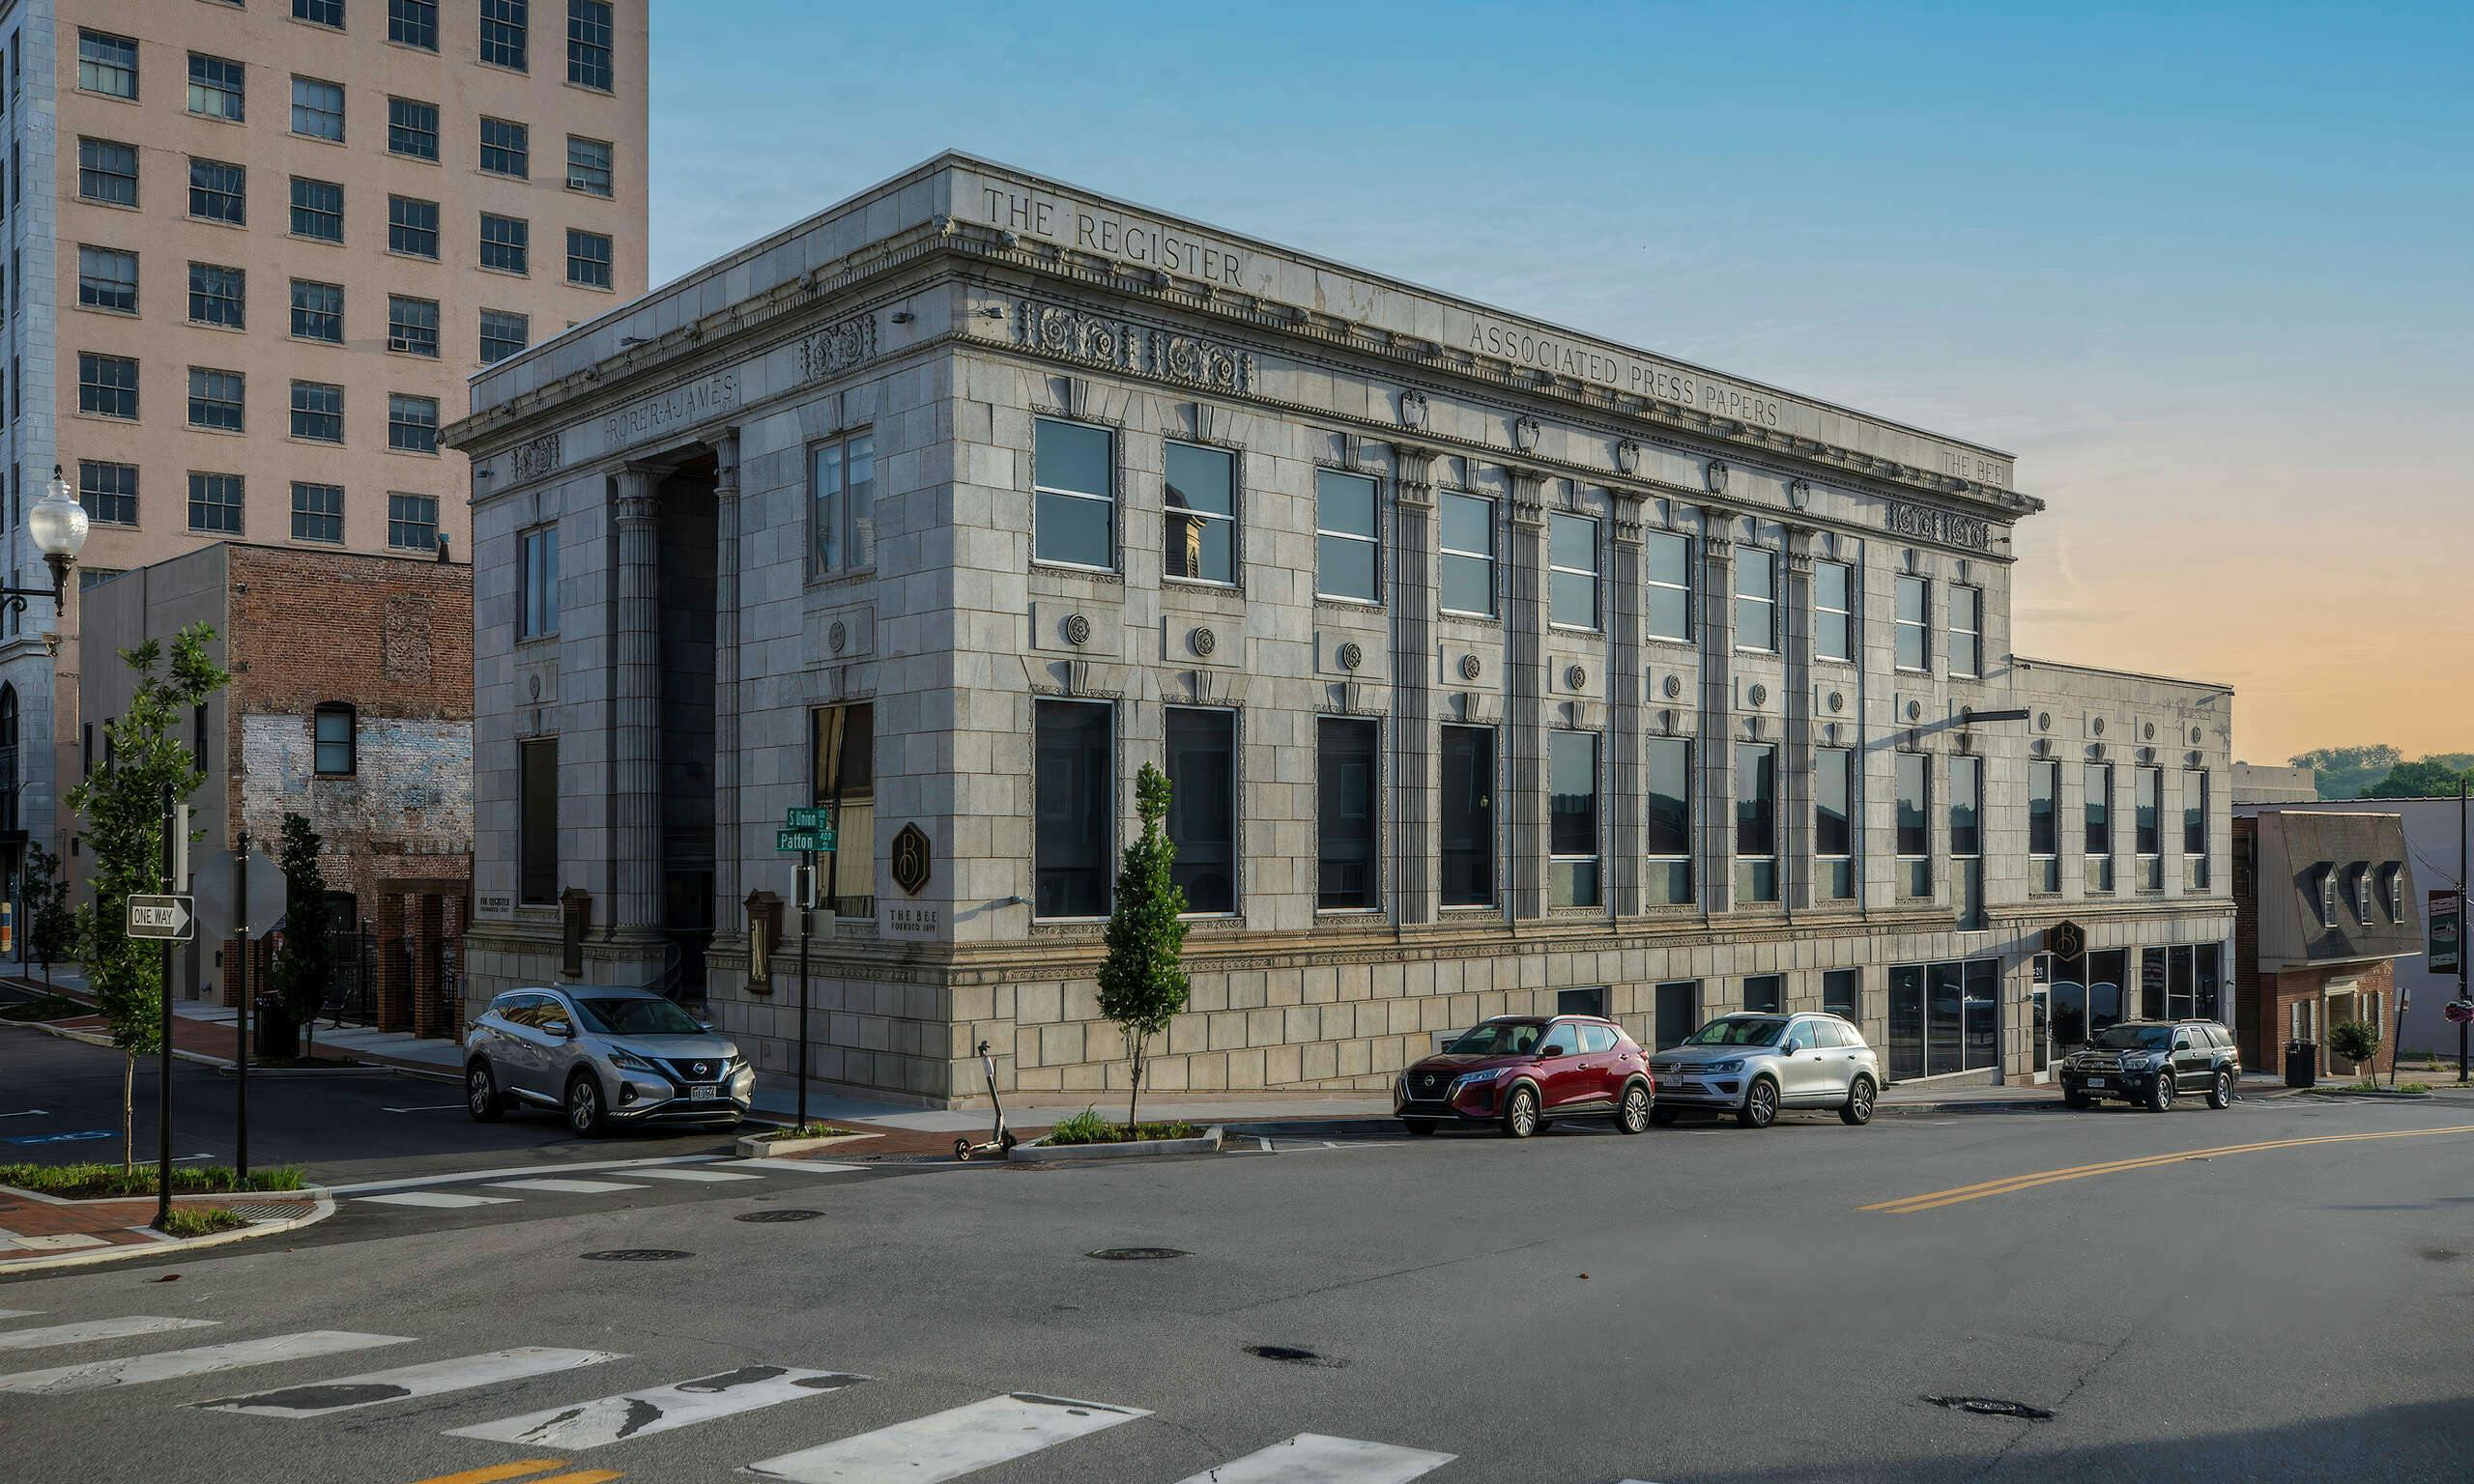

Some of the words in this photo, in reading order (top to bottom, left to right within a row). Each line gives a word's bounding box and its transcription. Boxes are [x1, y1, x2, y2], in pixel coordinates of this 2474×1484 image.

[985, 188, 1053, 237] THE
[1078, 214, 1243, 288] REGISTER
[1469, 322, 1618, 385] ASSOCIATED
[1631, 365, 1694, 405] PRESS
[1706, 385, 1777, 427] PAPERS
[1942, 451, 1971, 477] THE
[1977, 460, 2003, 486] BEE
[789, 810, 794, 826] S
[795, 811, 817, 827] Union
[781, 832, 814, 850] Patton
[134, 908, 153, 924] ONE
[155, 908, 173, 925] WAY
[889, 909, 911, 922] THE
[916, 910, 937, 924] BEE
